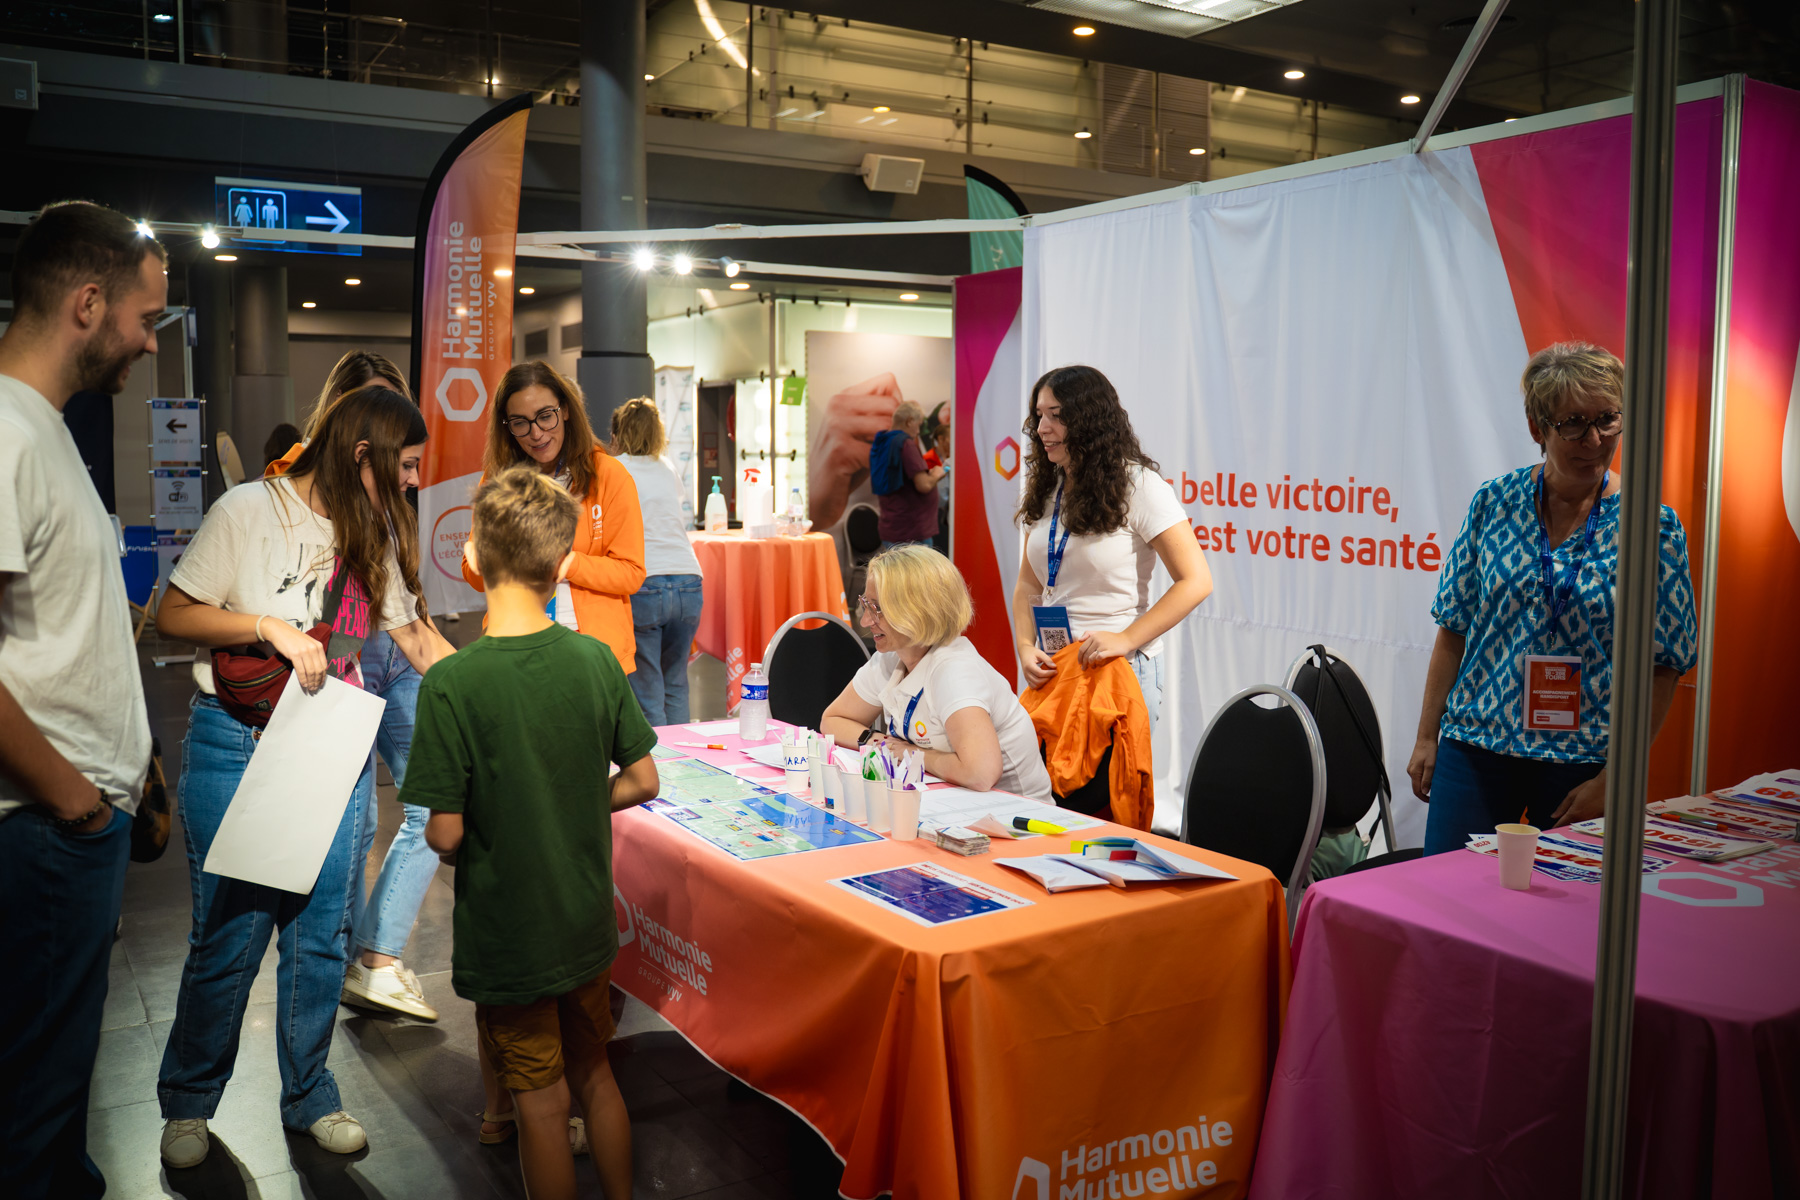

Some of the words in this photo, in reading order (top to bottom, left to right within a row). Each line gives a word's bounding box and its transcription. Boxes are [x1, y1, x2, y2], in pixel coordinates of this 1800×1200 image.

[443, 221, 465, 359] Harmonie
[463, 236, 483, 360] Mutuelle
[487, 280, 498, 308] vyv
[488, 313, 496, 361] GROUPE
[1180, 471, 1258, 509] belle
[1265, 474, 1399, 523] victoire,
[453, 540, 465, 549] VE
[1187, 517, 1237, 554] 'est
[1246, 525, 1331, 562] votre
[1340, 532, 1445, 573] santé
[632, 902, 713, 973] Harmonie
[638, 929, 707, 996] Mutuelle
[638, 966, 665, 990] GROUPE
[667, 984, 683, 1002] vyv
[1060, 1115, 1233, 1181] Harmonie
[1059, 1154, 1218, 1200] Mutuelle
